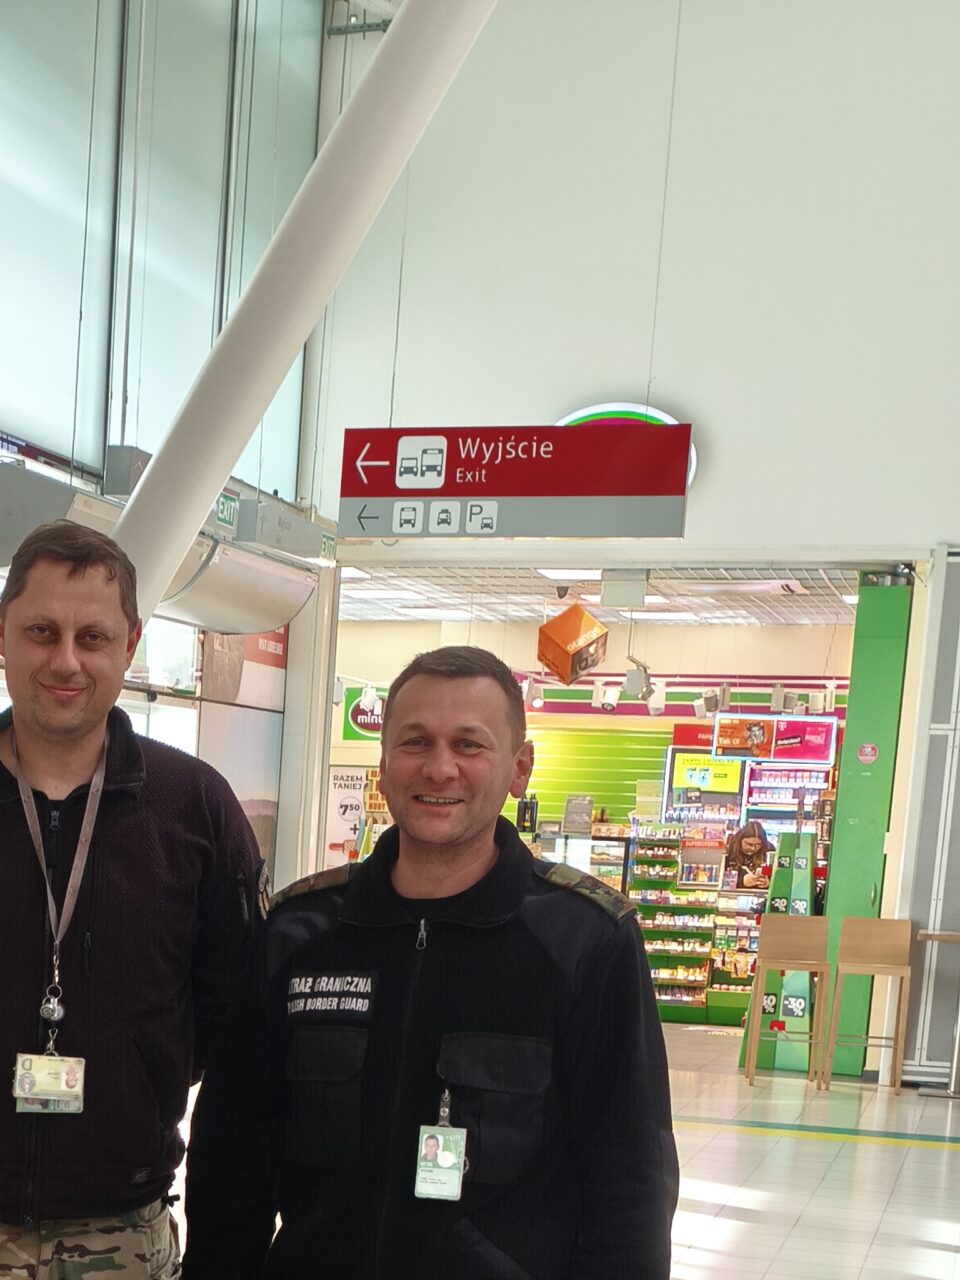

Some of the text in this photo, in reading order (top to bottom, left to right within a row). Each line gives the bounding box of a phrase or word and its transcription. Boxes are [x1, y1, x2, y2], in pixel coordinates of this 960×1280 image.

[458, 436, 554, 465] Wyjście
[456, 467, 487, 484] Exit
[218, 497, 236, 524] EXIT
[469, 505, 483, 523] P
[567, 626, 603, 652] orange
[357, 712, 383, 724] minu
[333, 774, 363, 782] RAZEM
[332, 782, 362, 790] TANIEJ
[771, 898, 787, 906] -20
[792, 900, 807, 908] -20
[314, 976, 372, 993] GRANICZNA
[305, 997, 338, 1011] BORDER
[339, 997, 369, 1012] GUARD
[784, 997, 805, 1008] -30
